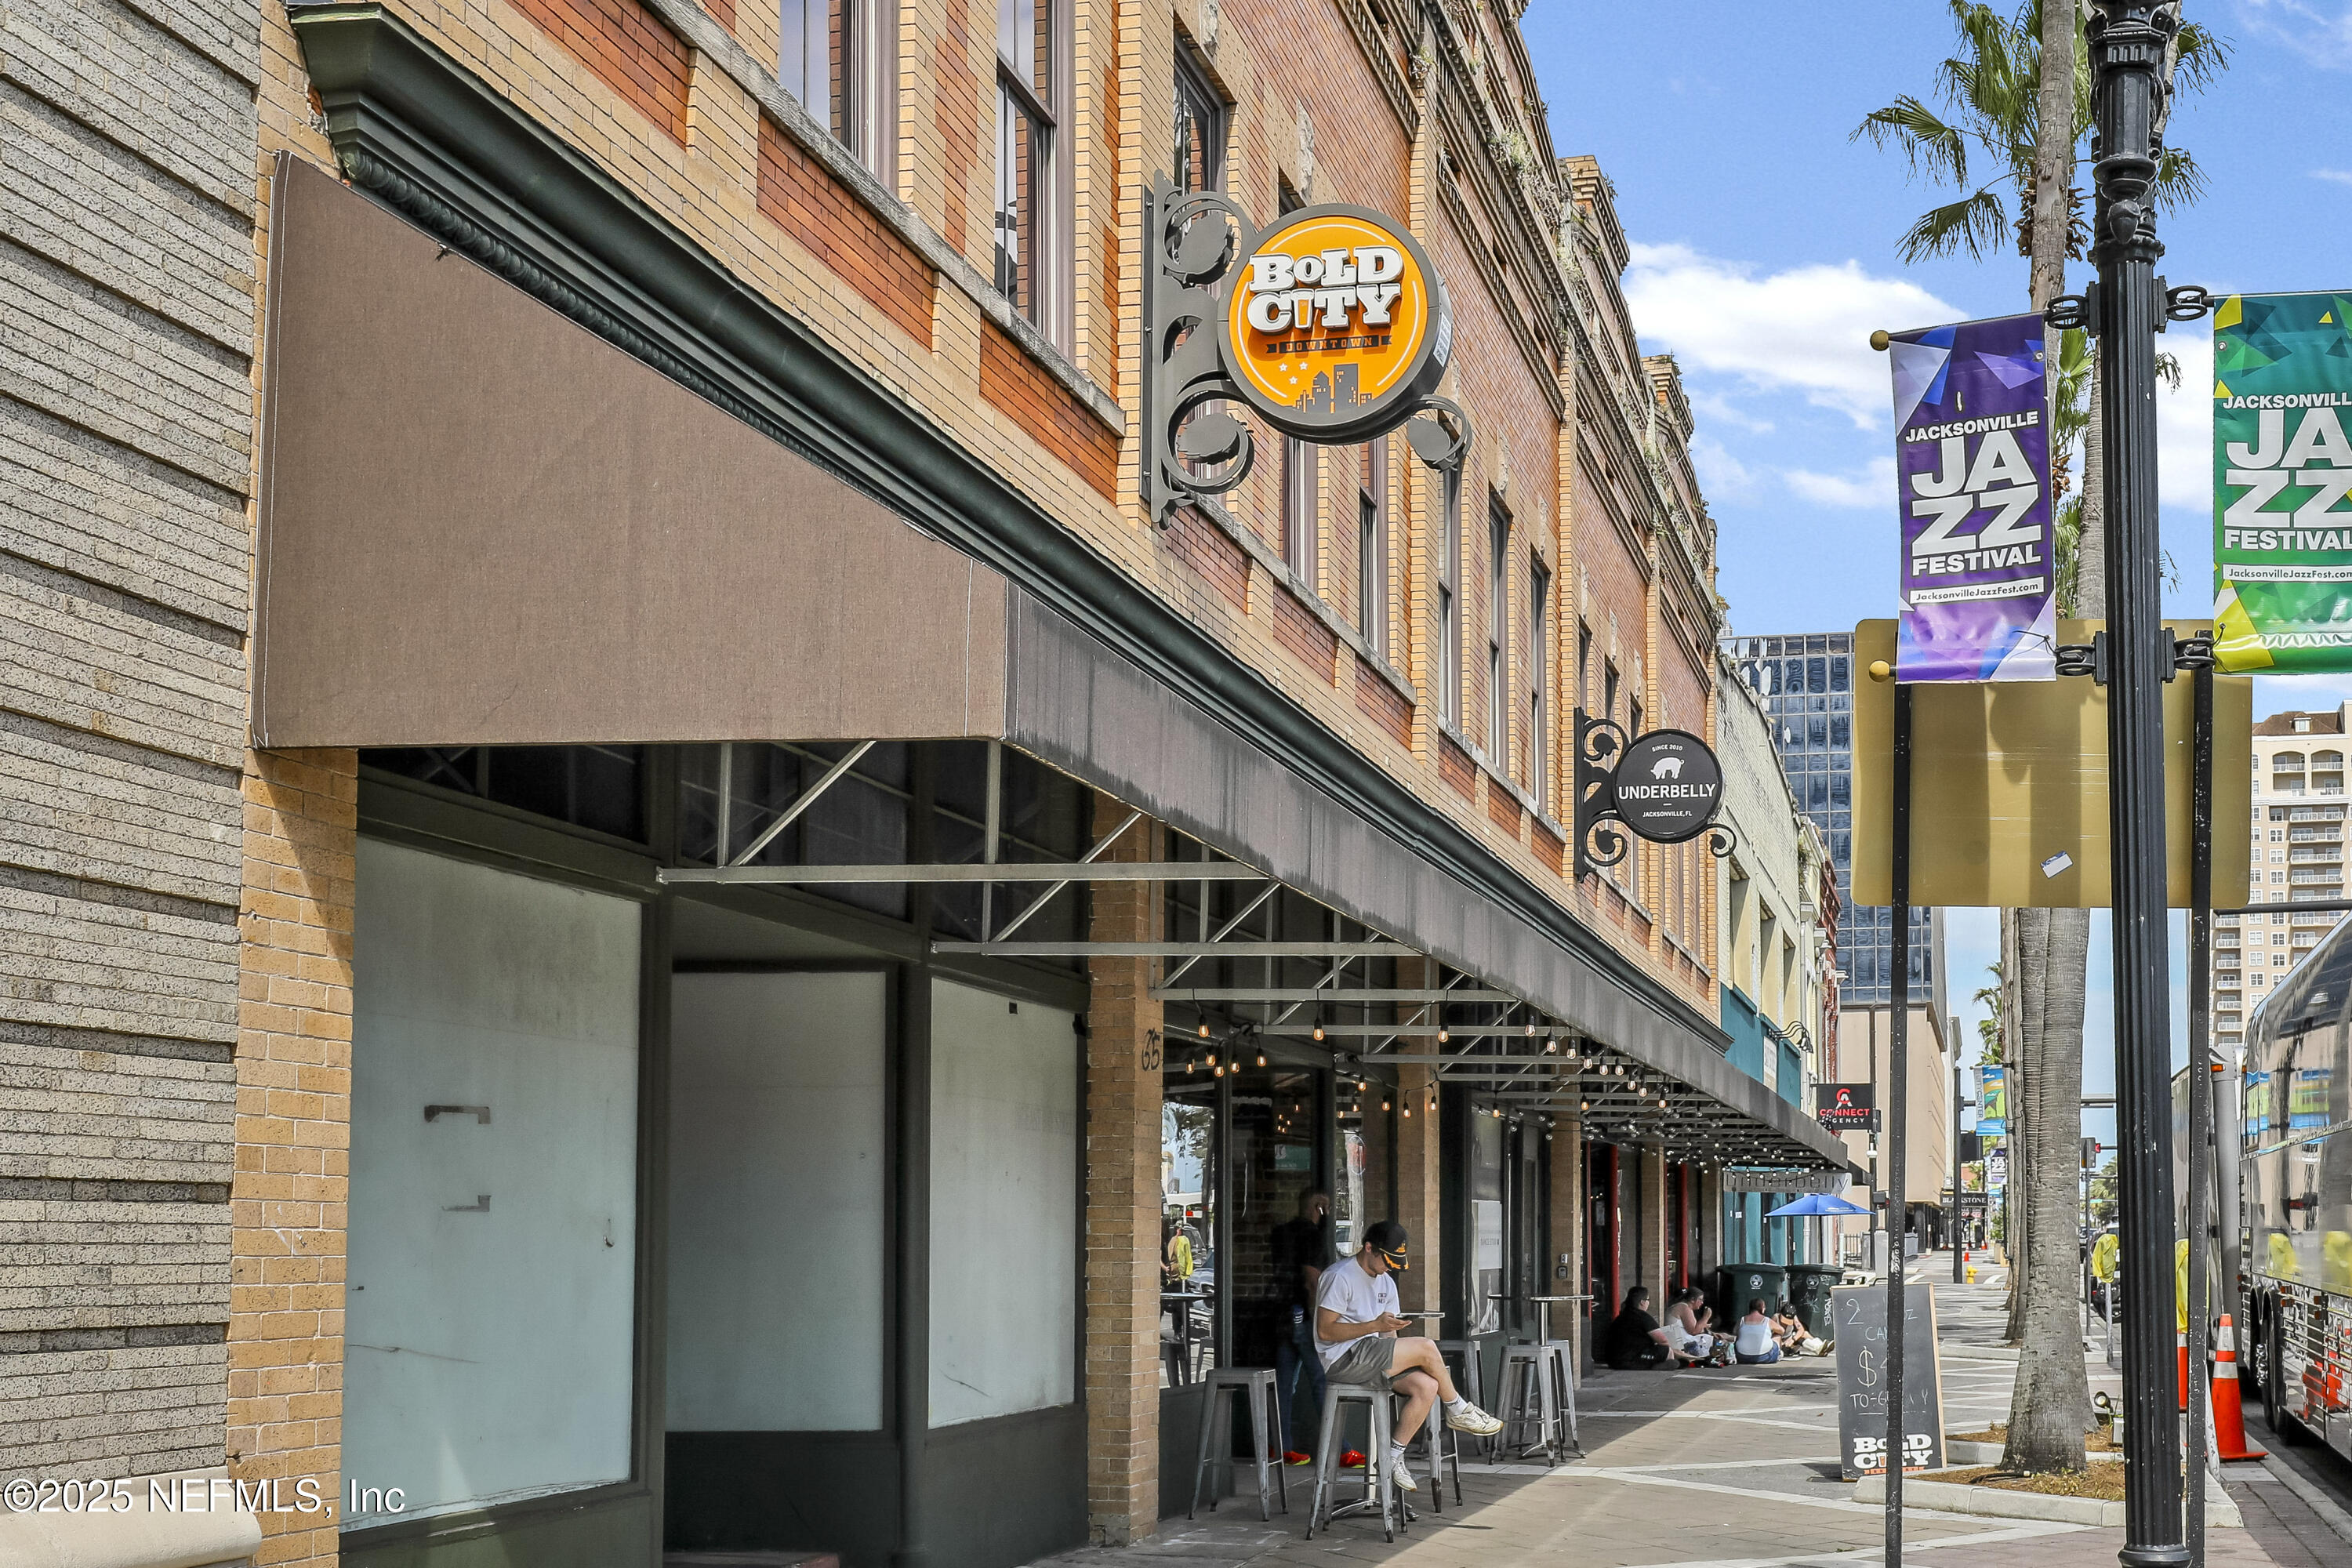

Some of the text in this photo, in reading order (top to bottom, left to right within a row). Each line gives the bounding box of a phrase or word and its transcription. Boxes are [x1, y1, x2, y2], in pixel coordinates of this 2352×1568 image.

[1285, 336, 1373, 352] DOWNTOWN
[2223, 393, 2352, 409] JACKSONVILL
[1905, 411, 2039, 443] JACKSONVILLE
[2226, 407, 2352, 469] JA
[1911, 429, 2036, 497] JA
[2223, 470, 2352, 528] ZZ
[1911, 484, 2042, 557] ZZ
[2224, 529, 2352, 550] FESTIVAL
[1911, 543, 2042, 576] FESTIVAL
[1916, 582, 2038, 601] JacksonvilleJazzFest.com
[1651, 744, 1668, 753] SINCE
[1618, 784, 1716, 800] UNDERBELLY
[1846, 1298, 1864, 1325] 2
